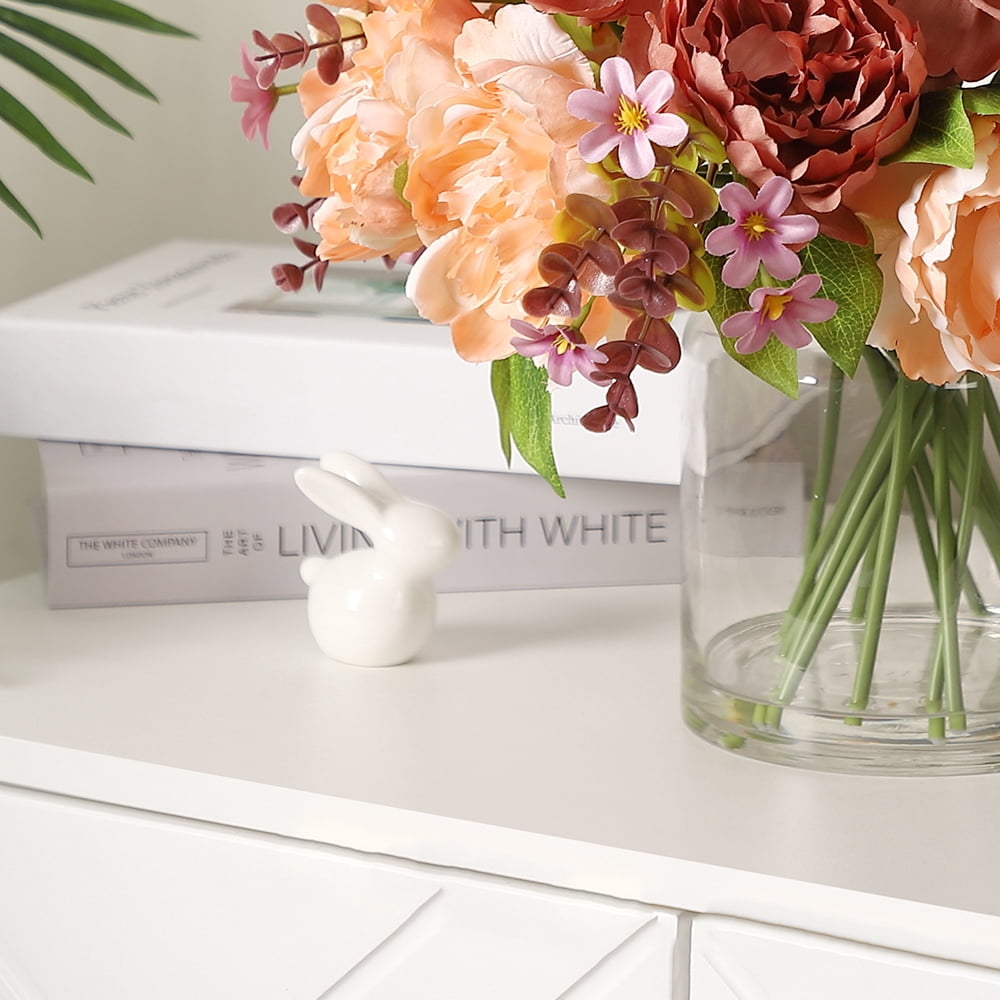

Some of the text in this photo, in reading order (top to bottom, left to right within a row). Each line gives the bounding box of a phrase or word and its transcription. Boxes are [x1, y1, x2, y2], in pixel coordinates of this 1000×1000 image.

[79, 535, 198, 551] THE WHITE COMPANY
[222, 529, 235, 556] THE
[278, 511, 668, 557] LIVIN ITH WHITE
